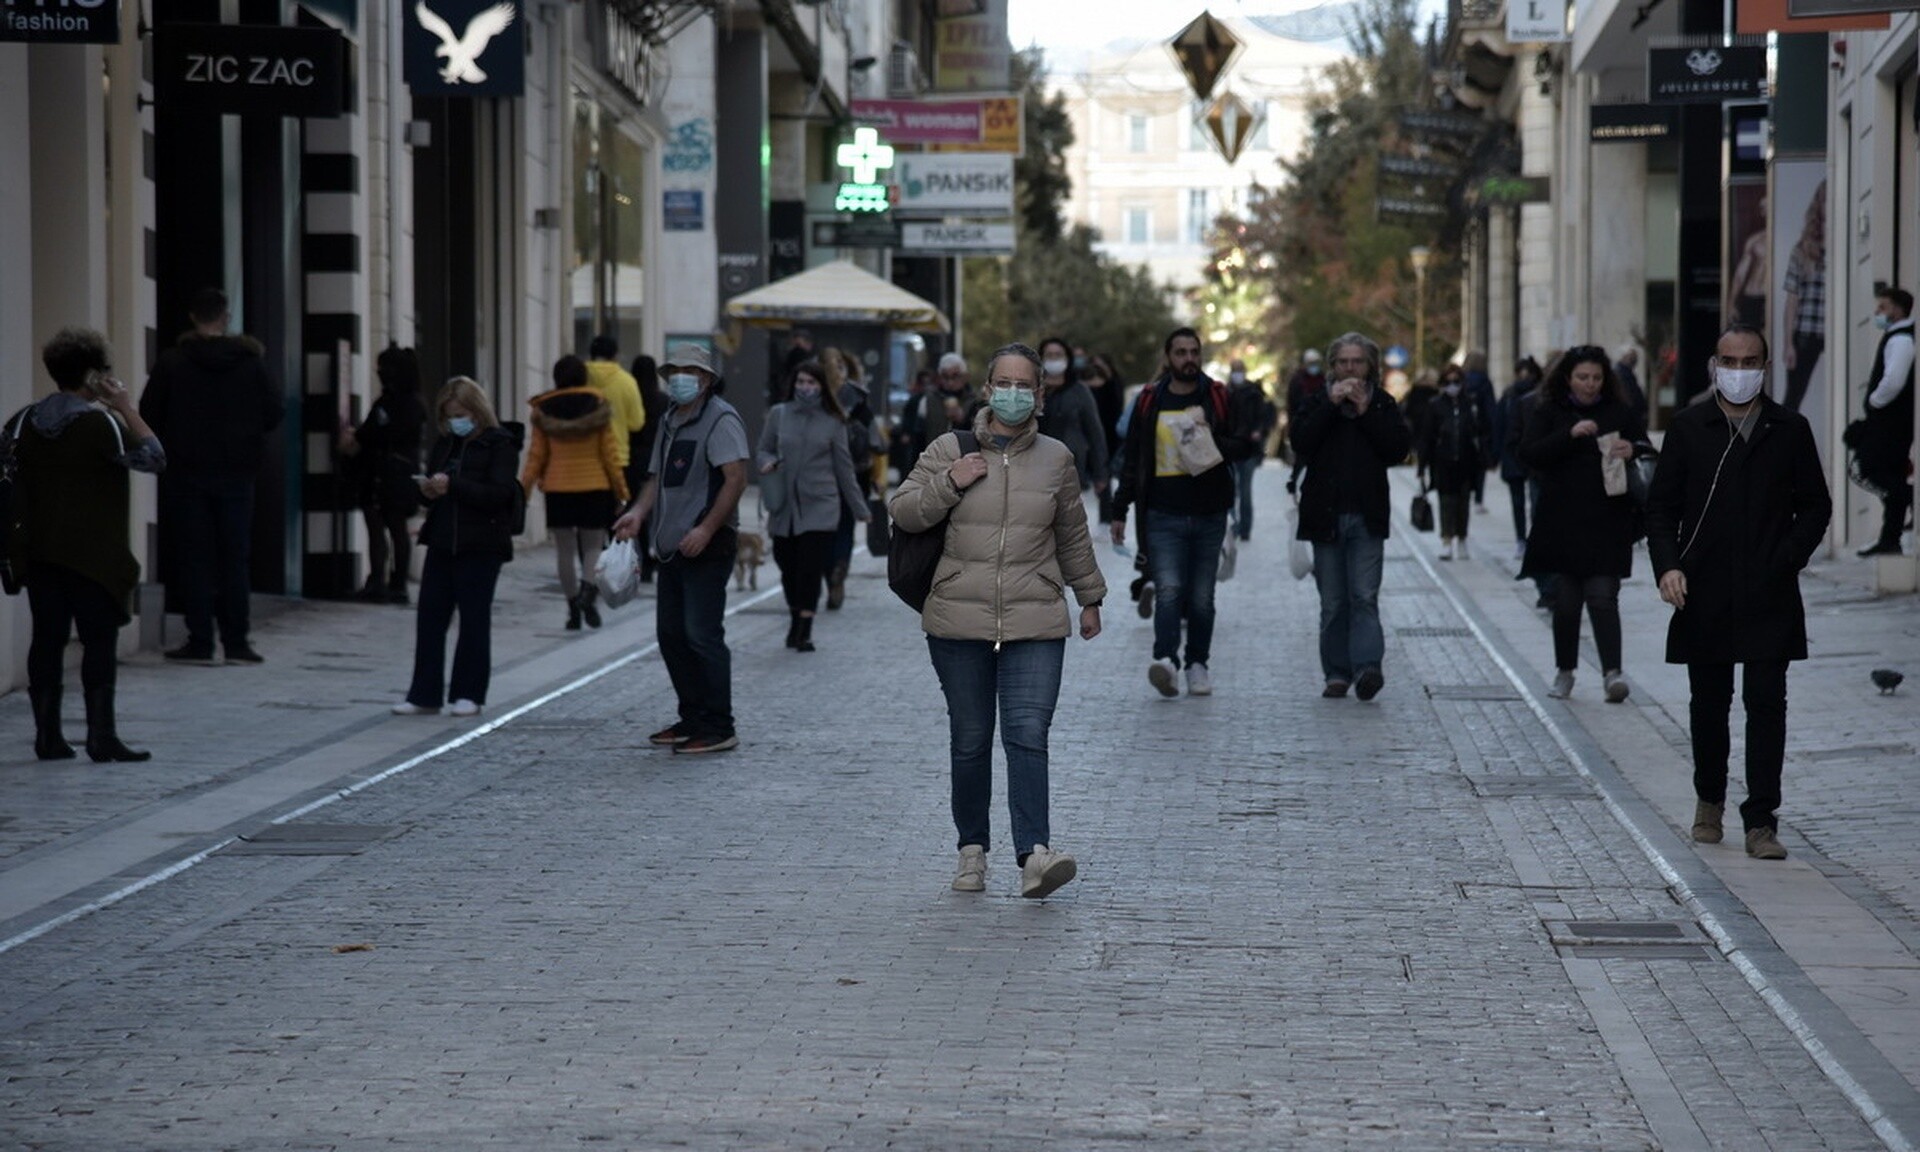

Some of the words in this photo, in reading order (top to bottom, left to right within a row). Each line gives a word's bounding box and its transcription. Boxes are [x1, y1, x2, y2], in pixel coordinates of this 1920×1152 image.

[1528, 1, 1544, 20] L
[7, 12, 89, 31] fashion
[185, 55, 239, 83] ZIC
[247, 57, 315, 86] ZAC
[903, 112, 978, 130] woman
